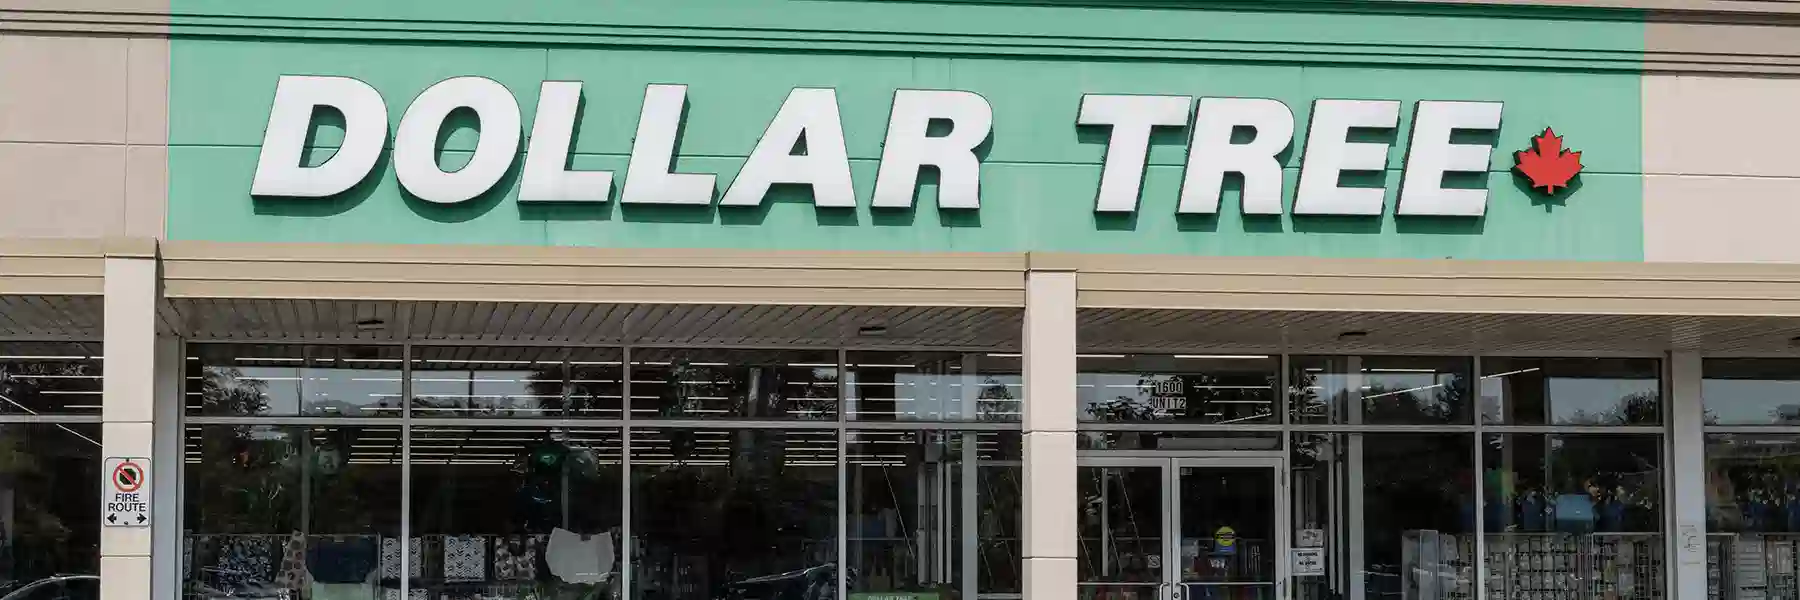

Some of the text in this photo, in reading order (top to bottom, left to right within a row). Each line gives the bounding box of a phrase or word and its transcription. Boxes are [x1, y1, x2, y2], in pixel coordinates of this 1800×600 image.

[250, 74, 1504, 217] DOLLAR TREE
[1157, 381, 1183, 393] 1600
[115, 493, 139, 502] FIRE
[108, 502, 146, 512] ROUTE
